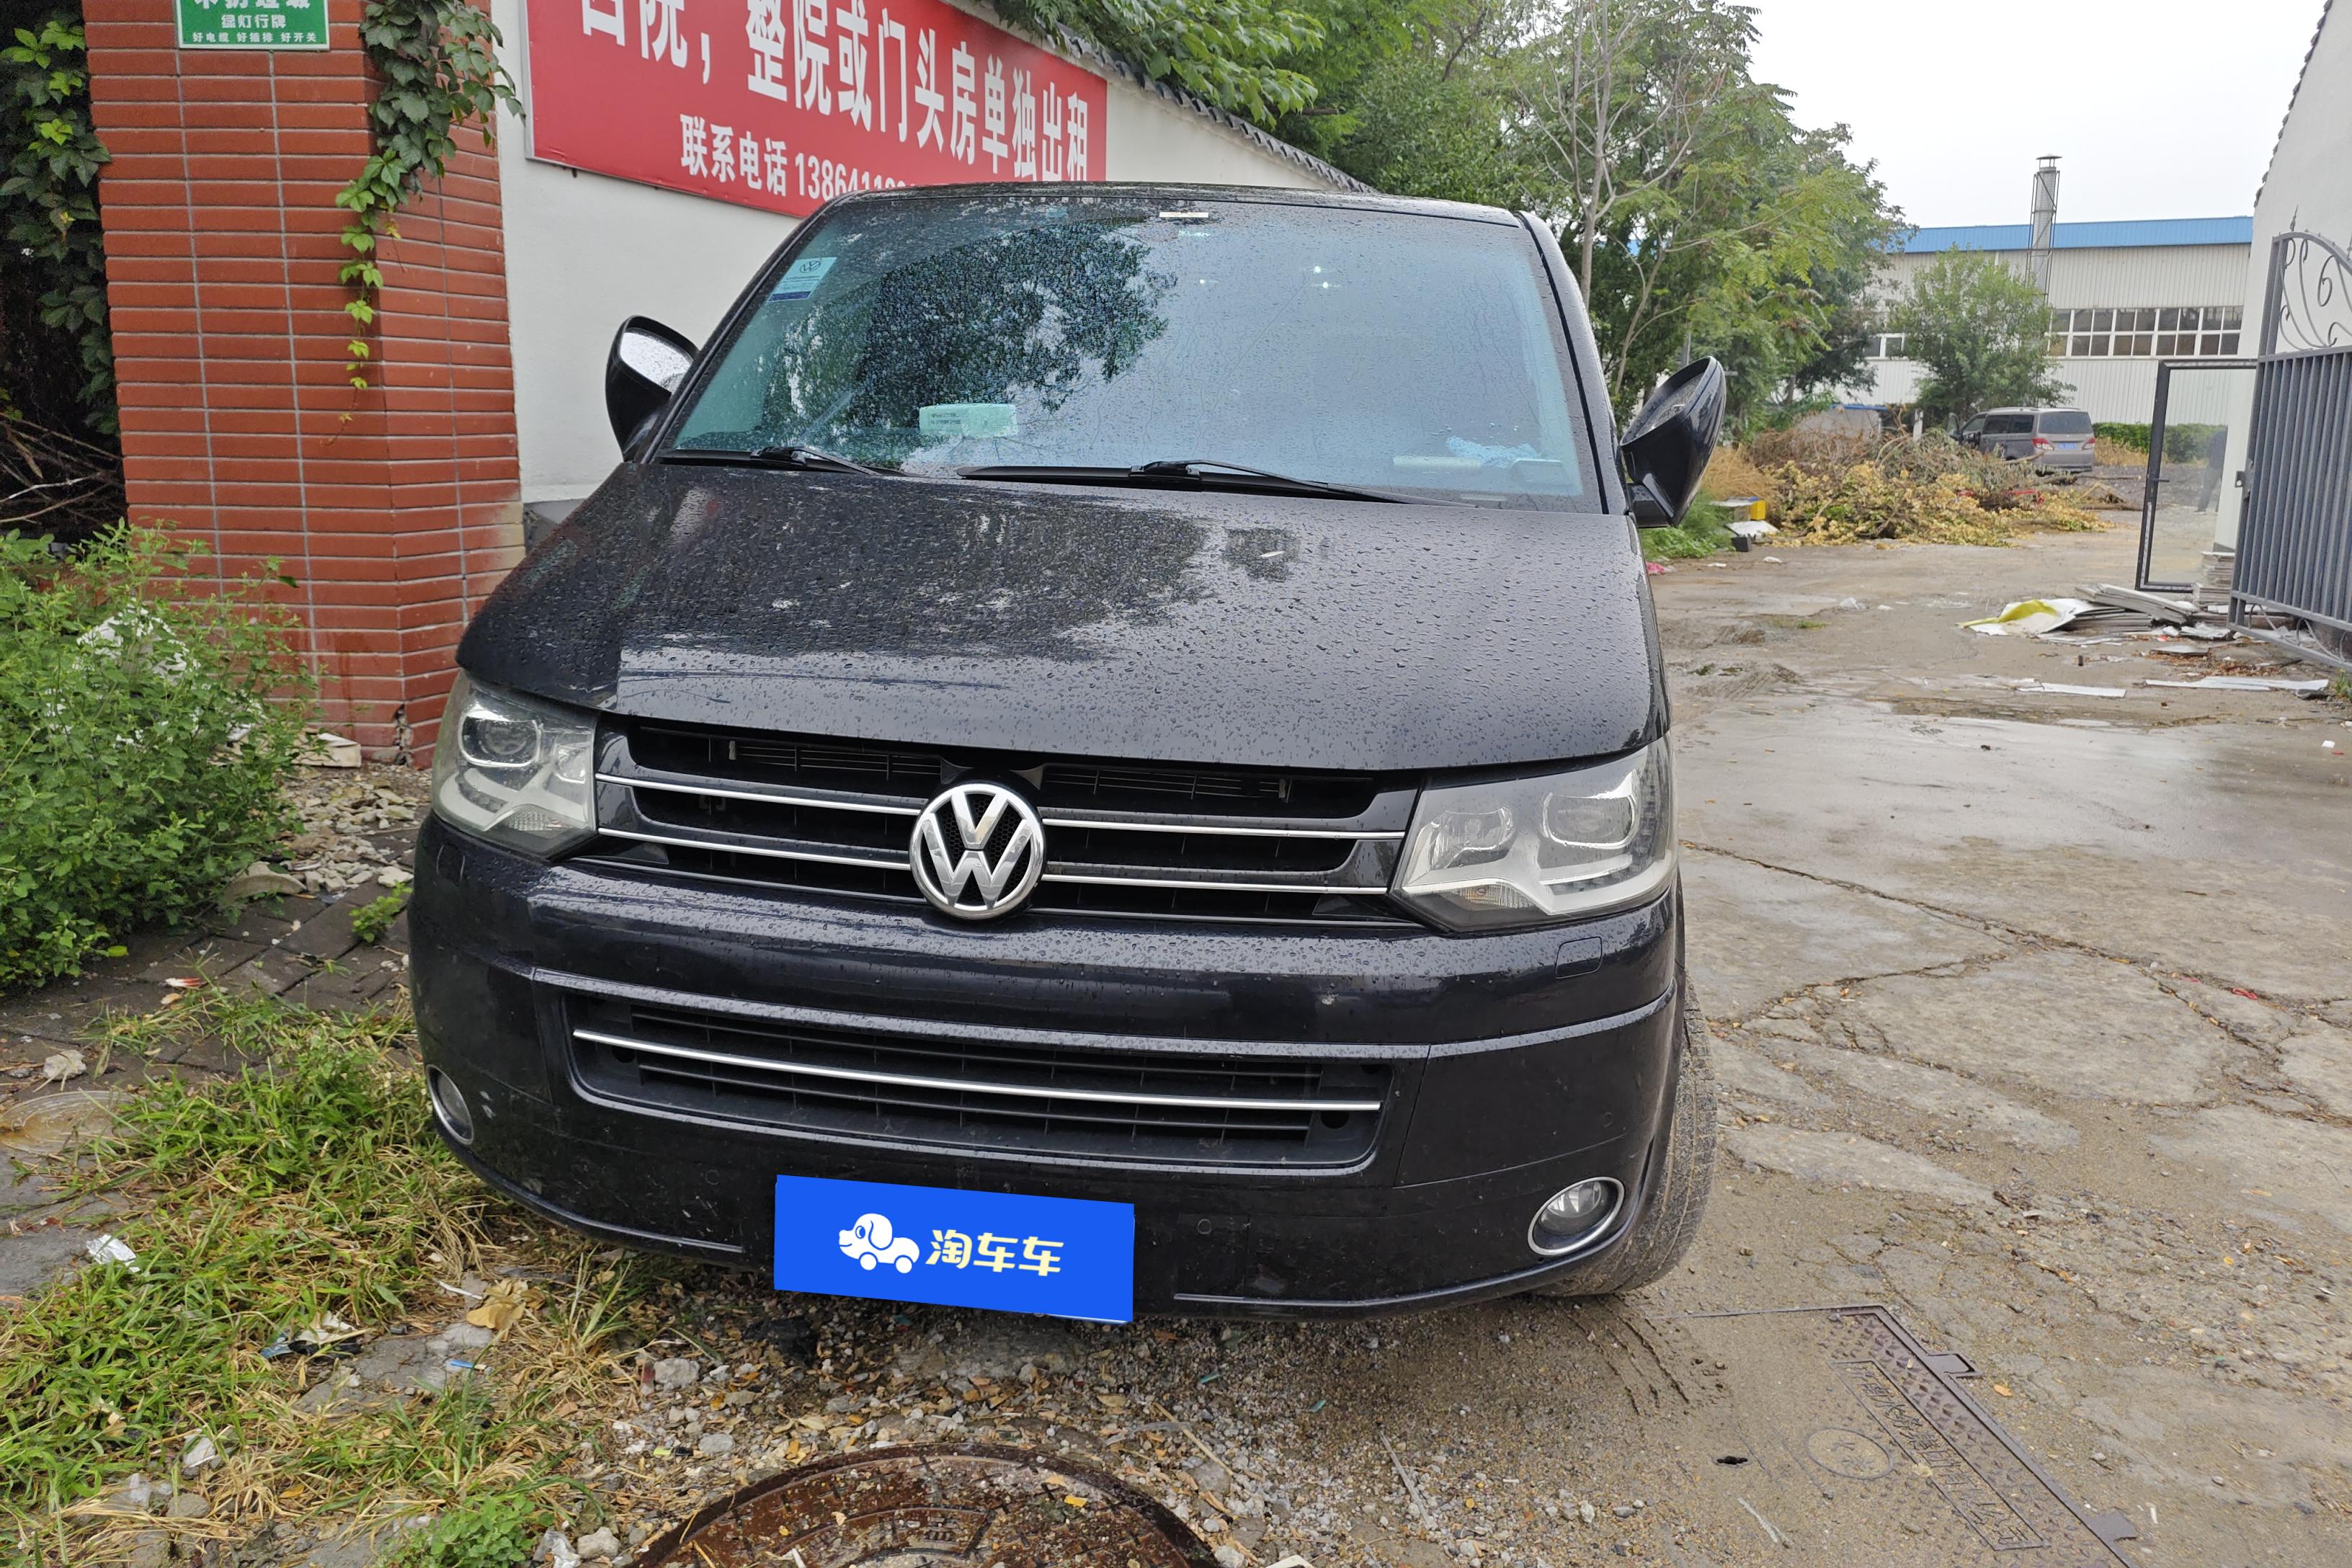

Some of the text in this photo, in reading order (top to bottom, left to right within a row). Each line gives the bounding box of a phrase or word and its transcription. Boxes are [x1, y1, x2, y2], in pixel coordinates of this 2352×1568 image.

[221, 14, 287, 29] 绿灯行牌
[192, 32, 317, 43] 好电缆 好插排 好开关
[680, 113, 788, 197] 联系电话
